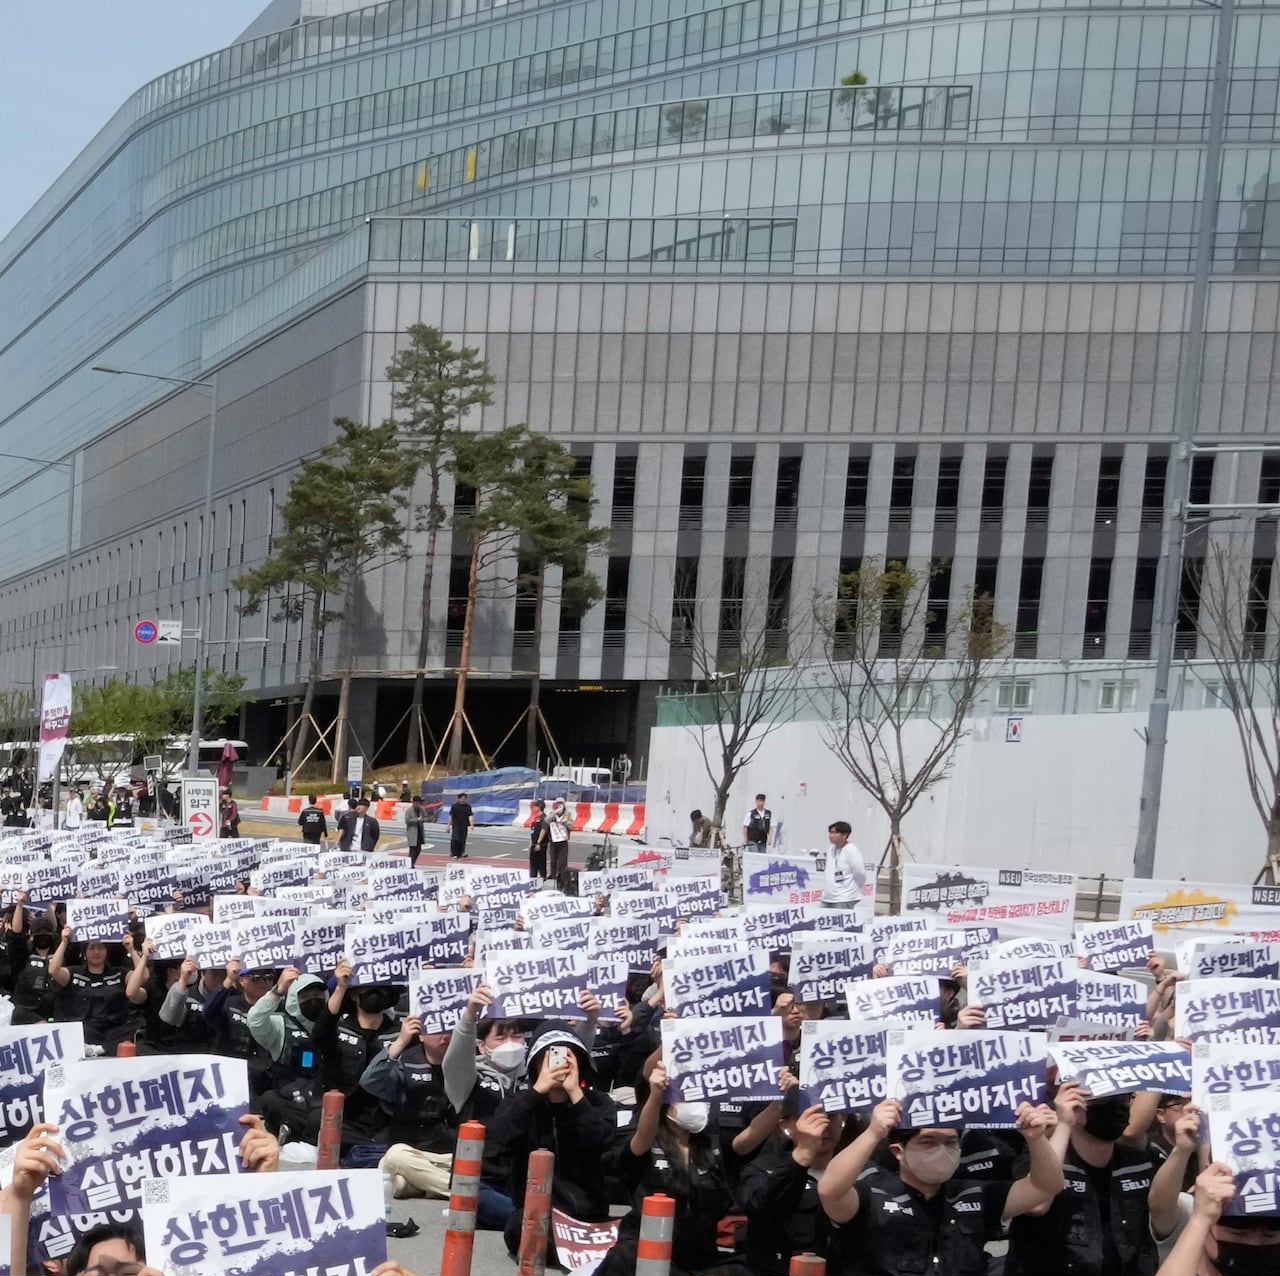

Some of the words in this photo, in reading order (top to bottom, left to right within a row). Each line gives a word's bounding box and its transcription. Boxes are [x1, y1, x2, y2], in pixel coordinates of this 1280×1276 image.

[190, 798, 210, 808] 입구
[26, 864, 71, 883] 상한폐지
[123, 866, 170, 886] 상한폐지
[1000, 872, 1021, 884] NSEU
[30, 886, 78, 903] 실현하자
[127, 885, 176, 904] 실현하자
[71, 902, 120, 921] 상한폐지
[743, 908, 806, 931] 상한폐지
[75, 923, 128, 941] 실현하자
[351, 928, 421, 956] 상한폐지
[892, 934, 954, 956] 상한폐지
[1082, 923, 1143, 949] 상한폐지
[356, 956, 432, 984] 실현하자
[495, 955, 576, 985] 상한폐지
[795, 946, 865, 974] 상한폐지
[893, 957, 959, 976] 실현하자
[1090, 945, 1153, 971] 실현하자
[1198, 946, 1270, 975] 상한폐지
[670, 954, 756, 996] 상한폐지
[974, 960, 1065, 999] 상한폐지
[502, 987, 581, 1017] 실현하자
[855, 981, 929, 1012] 상한폐지
[984, 993, 1076, 1028] 실현하자
[669, 1024, 768, 1070] 상한폐지
[898, 1035, 1007, 1083] 상한폐지
[680, 1064, 781, 1102] 실현하자
[1085, 1059, 1191, 1097] 실현하자
[60, 1063, 225, 1142] 상한폐지
[908, 1082, 1020, 1126] 실현하자
[967, 1160, 993, 1174] SELU
[1121, 1179, 1150, 1193] SELU
[162, 1178, 354, 1265] 상한폐지
